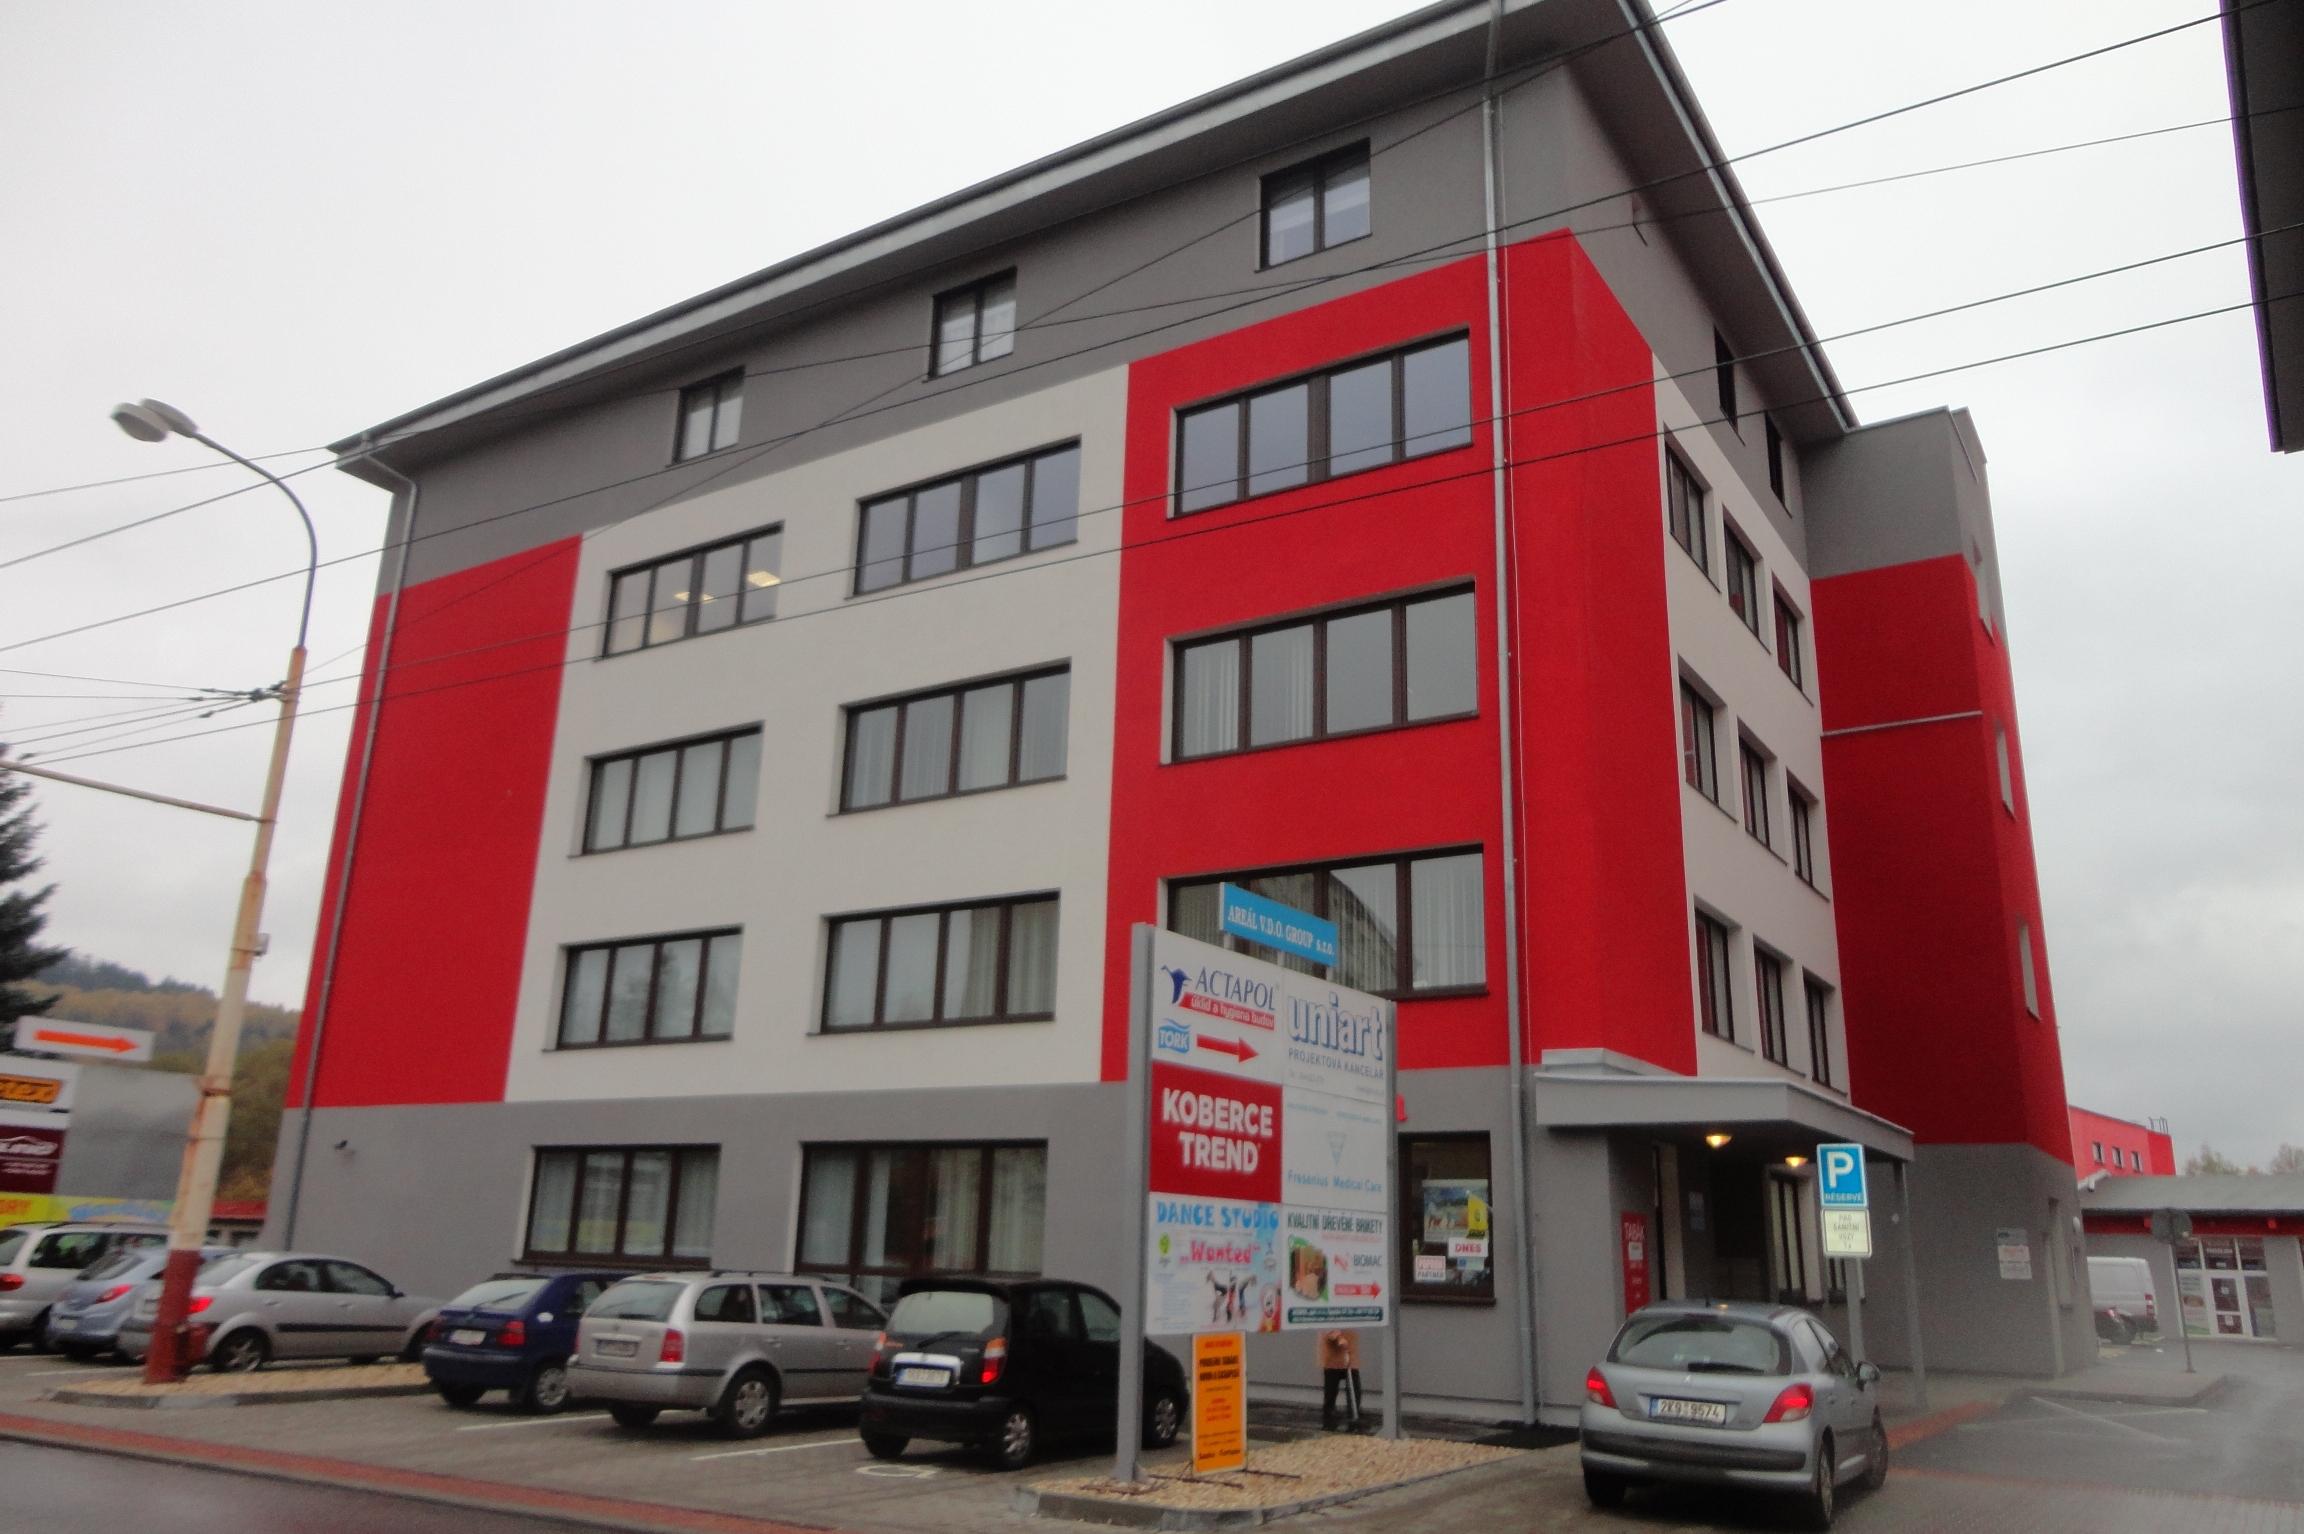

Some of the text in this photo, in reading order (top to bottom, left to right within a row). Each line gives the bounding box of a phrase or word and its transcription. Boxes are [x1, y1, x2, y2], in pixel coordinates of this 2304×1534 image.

[1228, 905, 1257, 929] AREÁL
[1286, 924, 1313, 948] GROUP
[1196, 966, 1275, 1010] ACTAPOL
[1251, 1011, 1274, 1027] budov
[1288, 991, 1383, 1061] uniart
[1160, 1029, 1189, 1050] TORK
[1162, 1087, 1273, 1137] KOBERCE
[1179, 1131, 1258, 1174] TREND
[1827, 1151, 1854, 1189] P
[1288, 1170, 1382, 1193] Fresenius Medical Care
[1157, 1201, 1280, 1231] DANCE STUDIO
[1455, 1243, 1482, 1254] DNES
